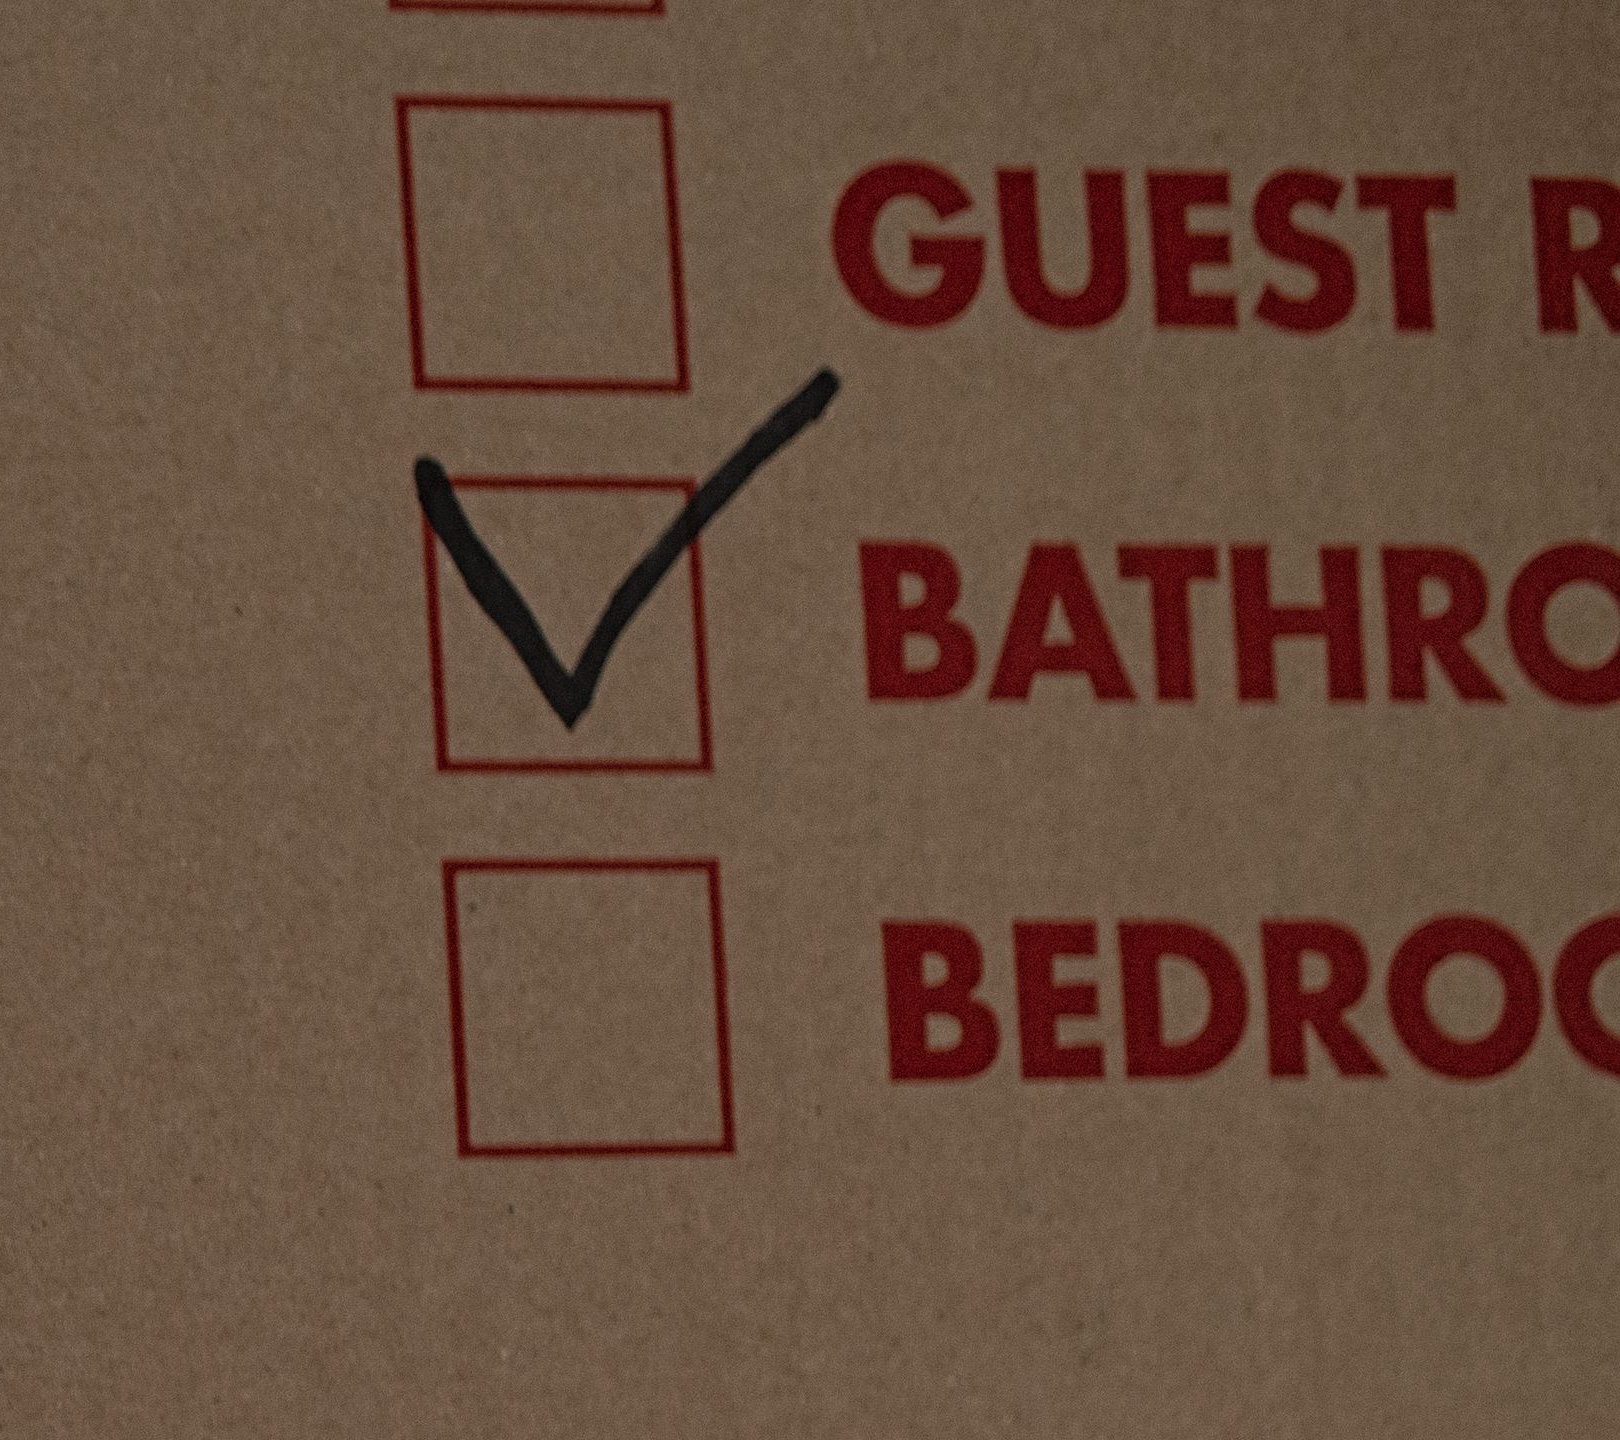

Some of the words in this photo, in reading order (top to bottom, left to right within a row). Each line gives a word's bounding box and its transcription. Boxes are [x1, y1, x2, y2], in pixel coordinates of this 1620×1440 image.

[830, 160, 1457, 335] GUEST
[1529, 176, 1620, 335] R
[857, 539, 1620, 708] BATHRO
